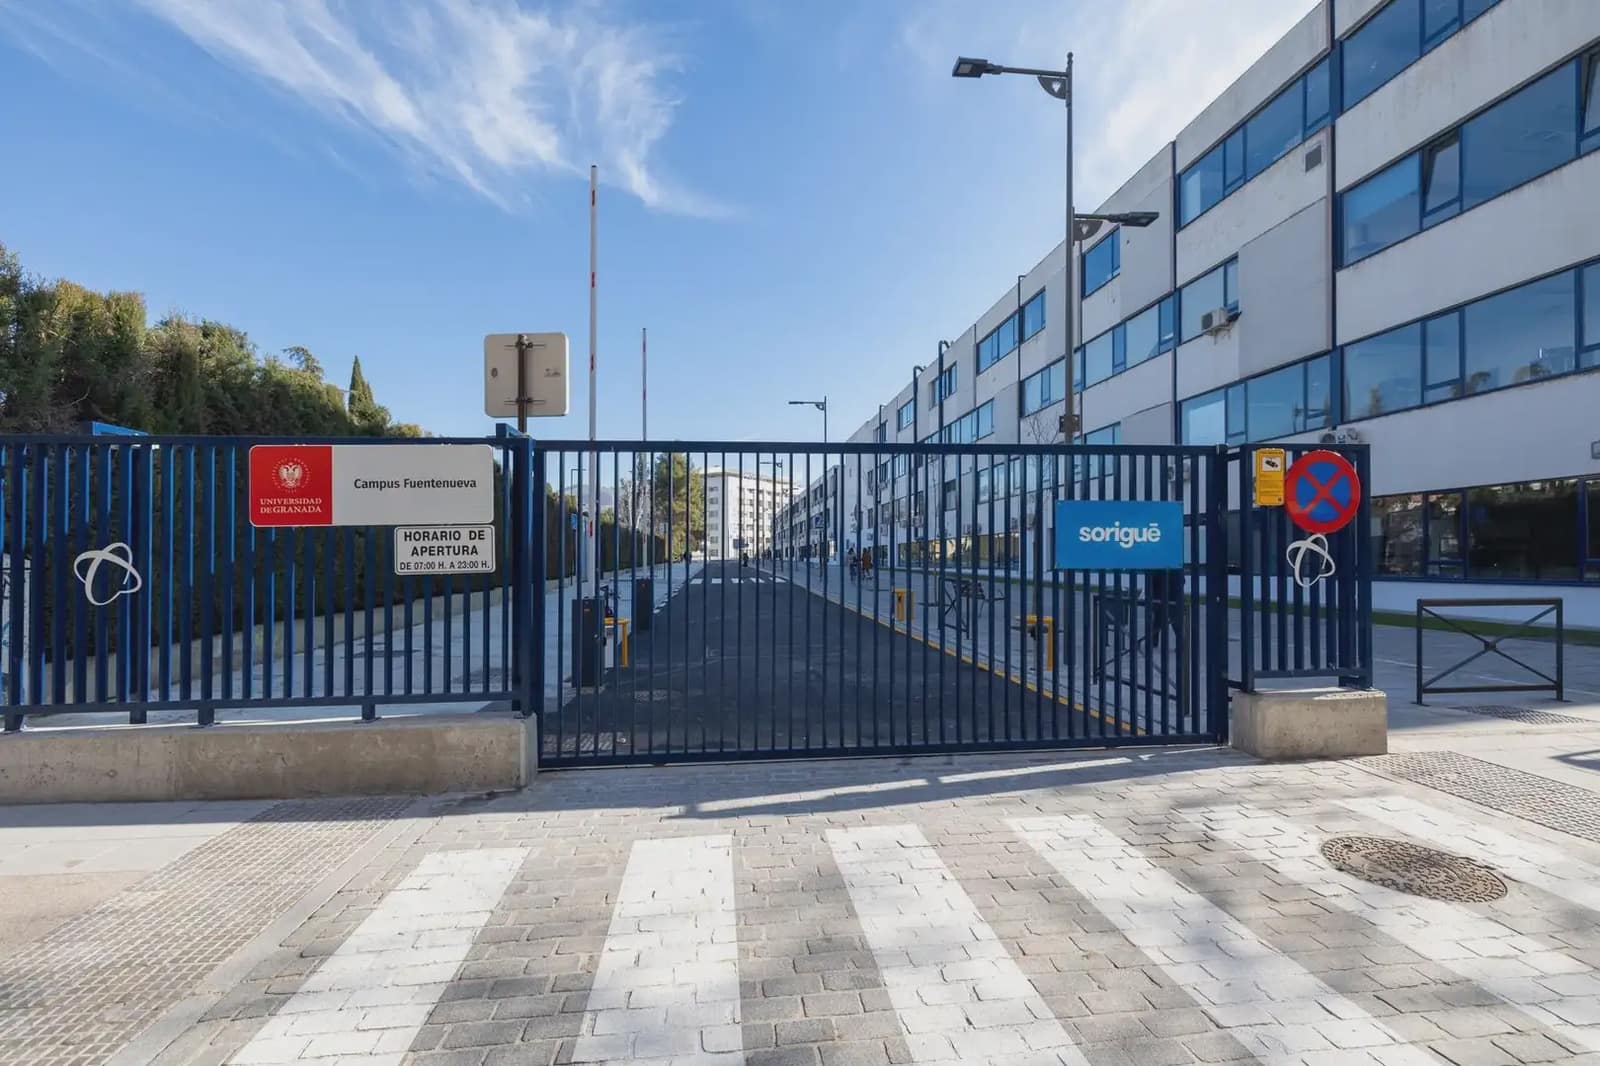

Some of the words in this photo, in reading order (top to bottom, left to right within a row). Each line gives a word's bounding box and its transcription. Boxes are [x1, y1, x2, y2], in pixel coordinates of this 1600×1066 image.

[354, 478, 400, 491] Campus
[403, 478, 477, 488] Fuentenueva
[260, 497, 322, 505] UNIVERSIDAD
[260, 506, 272, 514] DE
[273, 505, 322, 513] GRANADA
[404, 530, 462, 541] HORARIO
[469, 529, 485, 540] DE
[411, 545, 478, 556] APERTURA
[399, 562, 412, 571] DE
[414, 561, 436, 570] 07:00
[438, 561, 447, 570] H.
[449, 561, 456, 570] A
[457, 560, 479, 569] 23:00
[481, 560, 490, 569] H.
